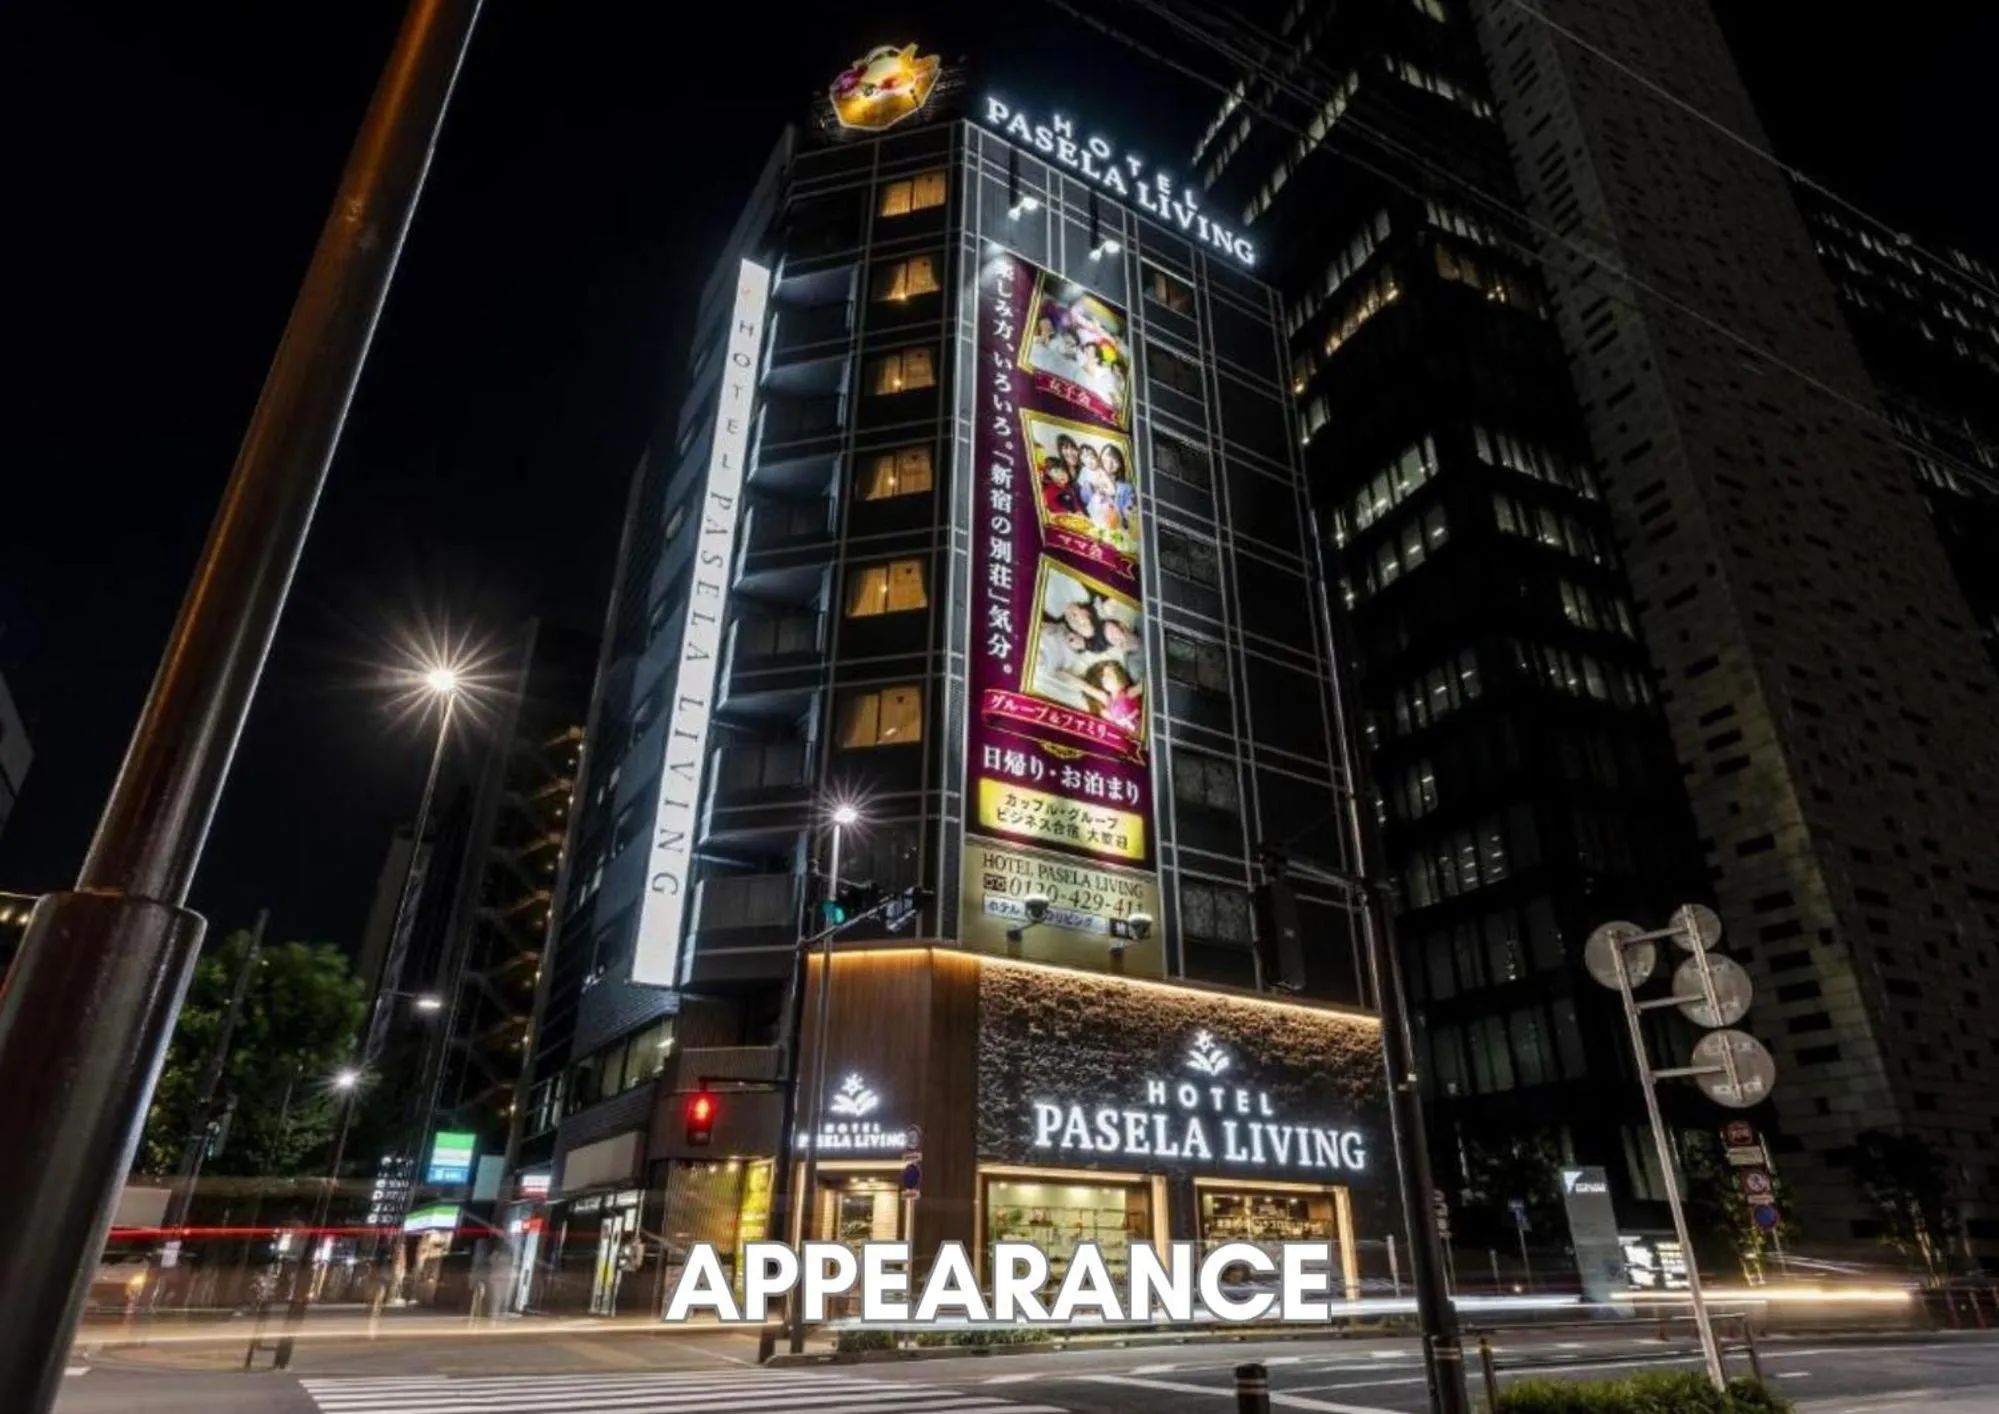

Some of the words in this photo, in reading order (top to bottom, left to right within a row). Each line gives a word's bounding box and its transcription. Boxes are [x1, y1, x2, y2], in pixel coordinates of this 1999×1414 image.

[985, 97, 1127, 195] PASELA
[1136, 180, 1255, 264] LIVING
[1052, 113, 1197, 209] HOTEL
[721, 319, 754, 469] HOTEL
[686, 490, 733, 663] PASELA
[651, 695, 705, 897] LIVING
[983, 744, 1140, 805] 日帰り・お泊まり
[983, 852, 1032, 877] HOTEL
[1038, 863, 1091, 889] PASELA
[1095, 874, 1144, 899] LIVING
[1034, 1103, 1211, 1159] PASELA
[1223, 1121, 1366, 1170] LIVING
[1149, 1080, 1275, 1116] HOTEL
